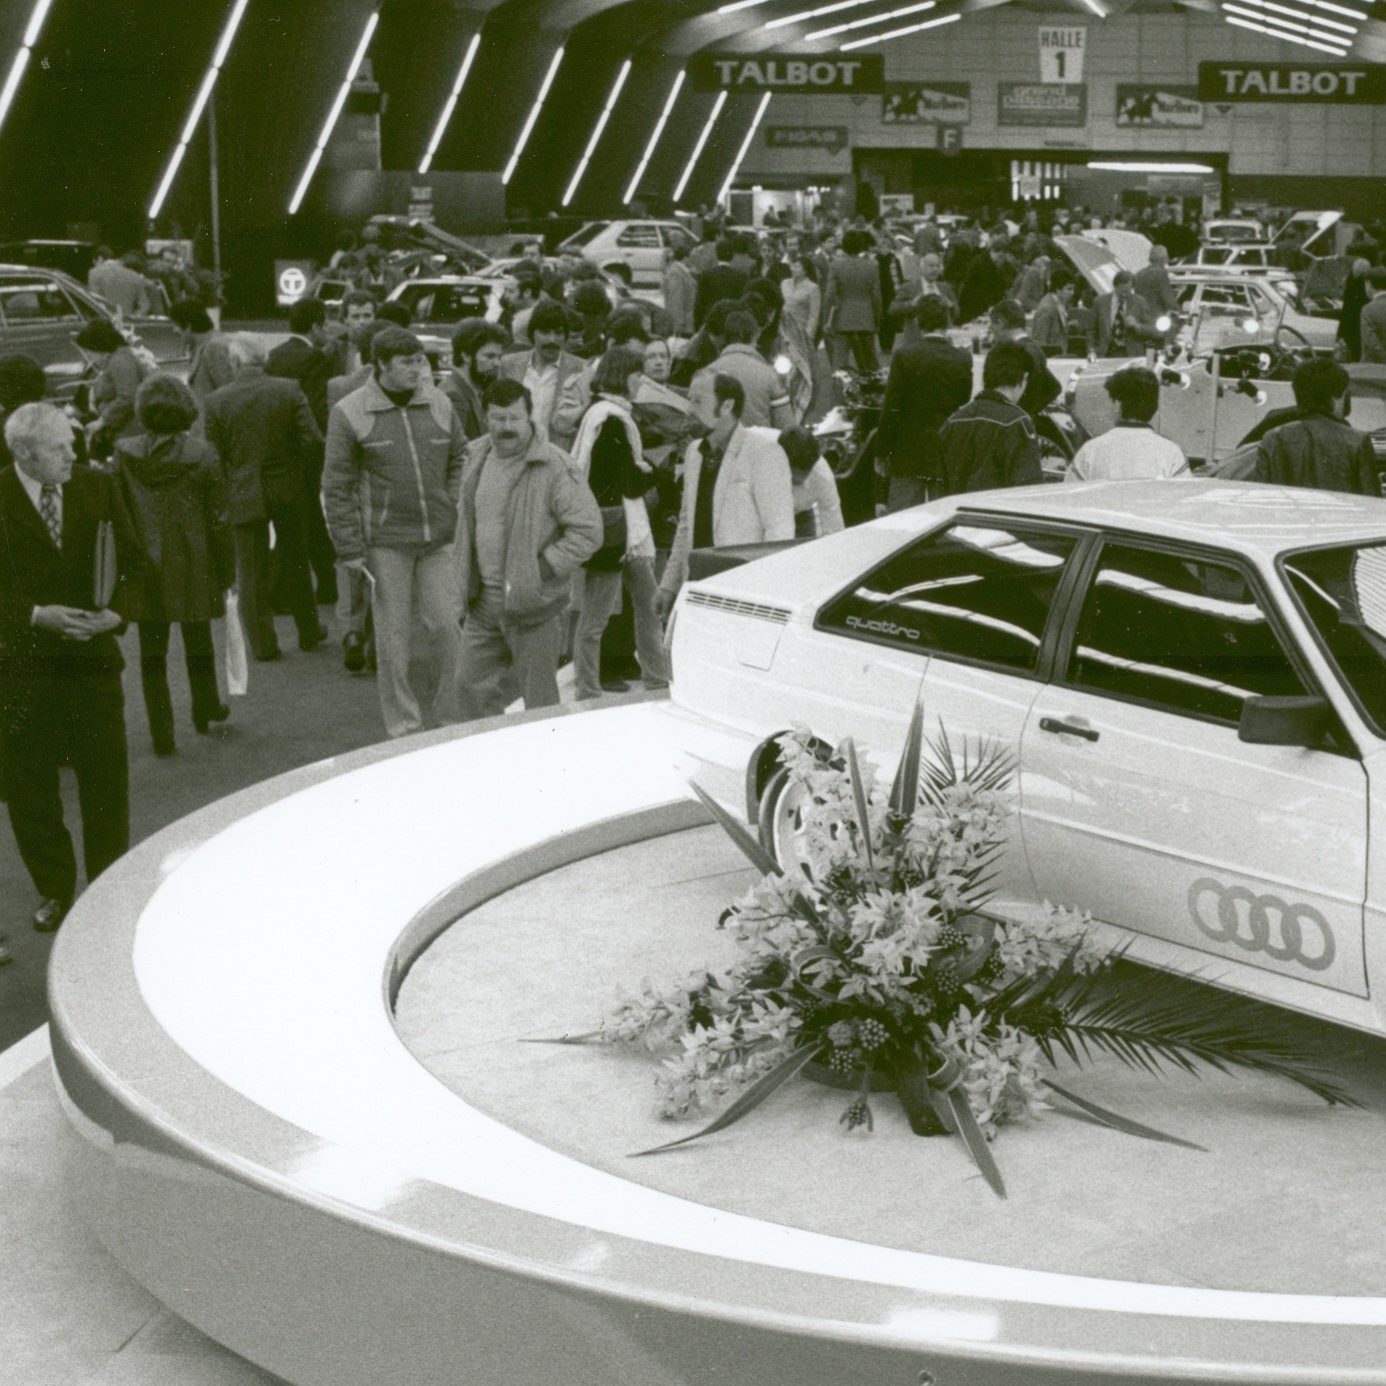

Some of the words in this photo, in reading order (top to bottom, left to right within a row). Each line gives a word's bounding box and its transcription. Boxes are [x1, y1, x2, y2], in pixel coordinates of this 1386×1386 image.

[1040, 31, 1084, 48] HALLE
[714, 60, 862, 86] TALBOT
[1055, 51, 1066, 79] 1
[1219, 69, 1367, 96] TALBOT
[1157, 99, 1201, 114] Marlboro
[943, 129, 956, 149] F
[846, 615, 920, 640] quattro
